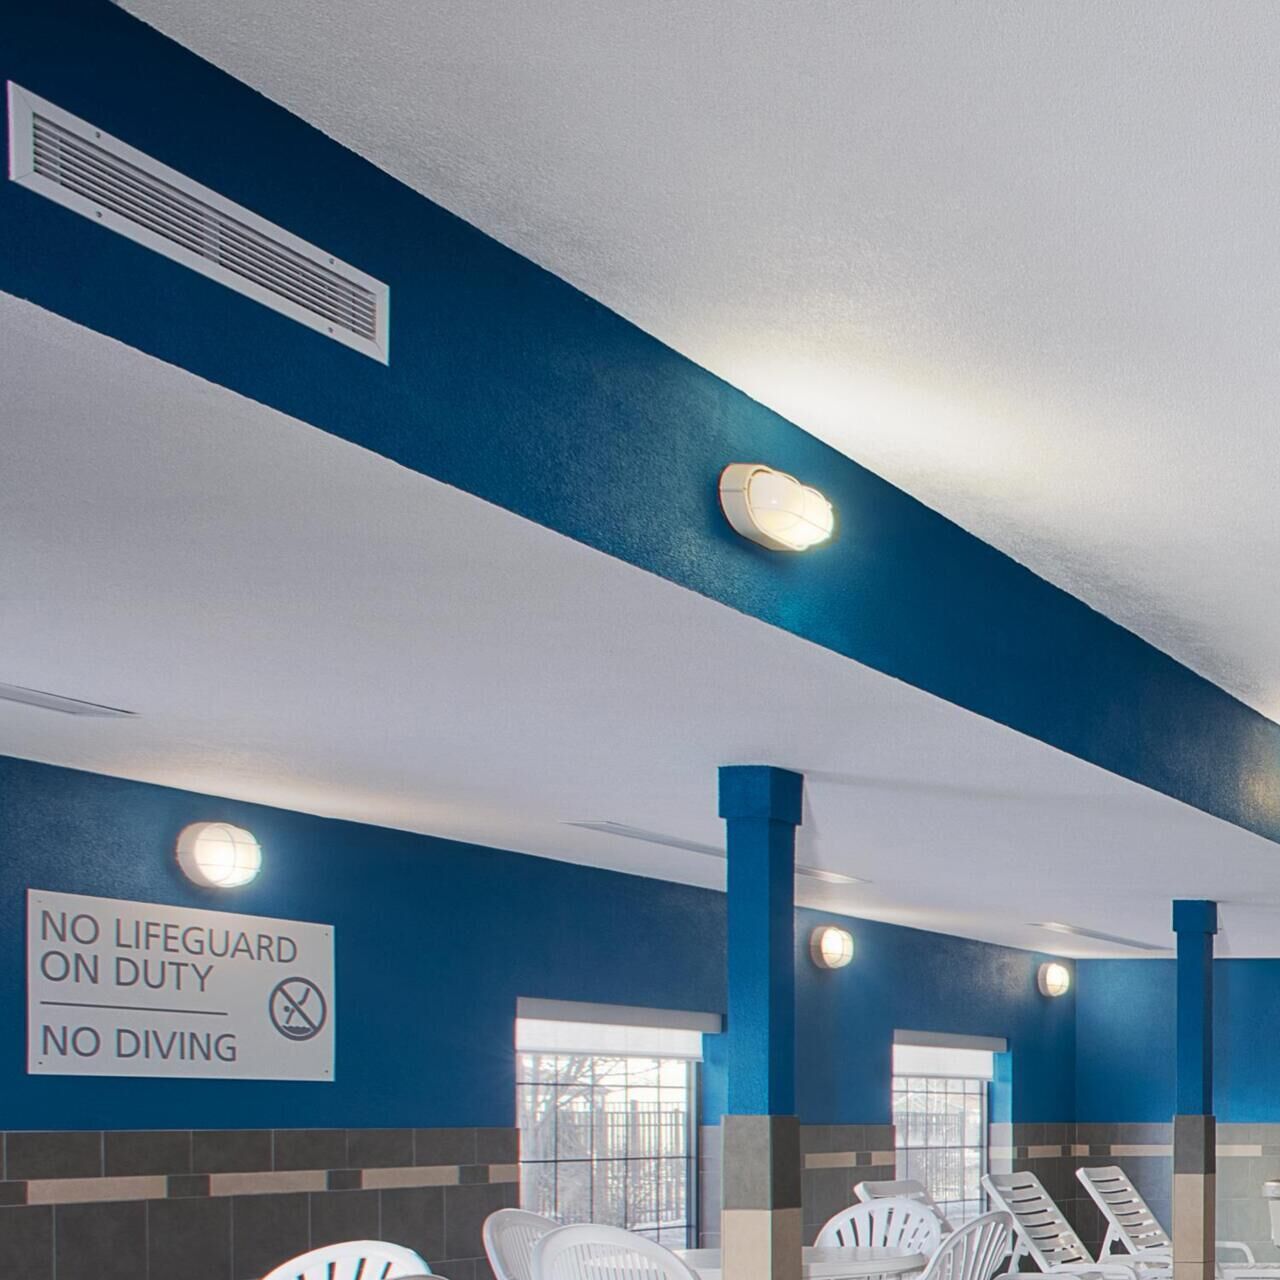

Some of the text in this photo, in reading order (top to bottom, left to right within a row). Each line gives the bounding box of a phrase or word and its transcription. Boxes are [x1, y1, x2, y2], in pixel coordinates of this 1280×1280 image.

[40, 909, 298, 964] NO LIFEGUARD
[39, 949, 214, 992] ON DUTY
[41, 1024, 238, 1062] NO DIVING
